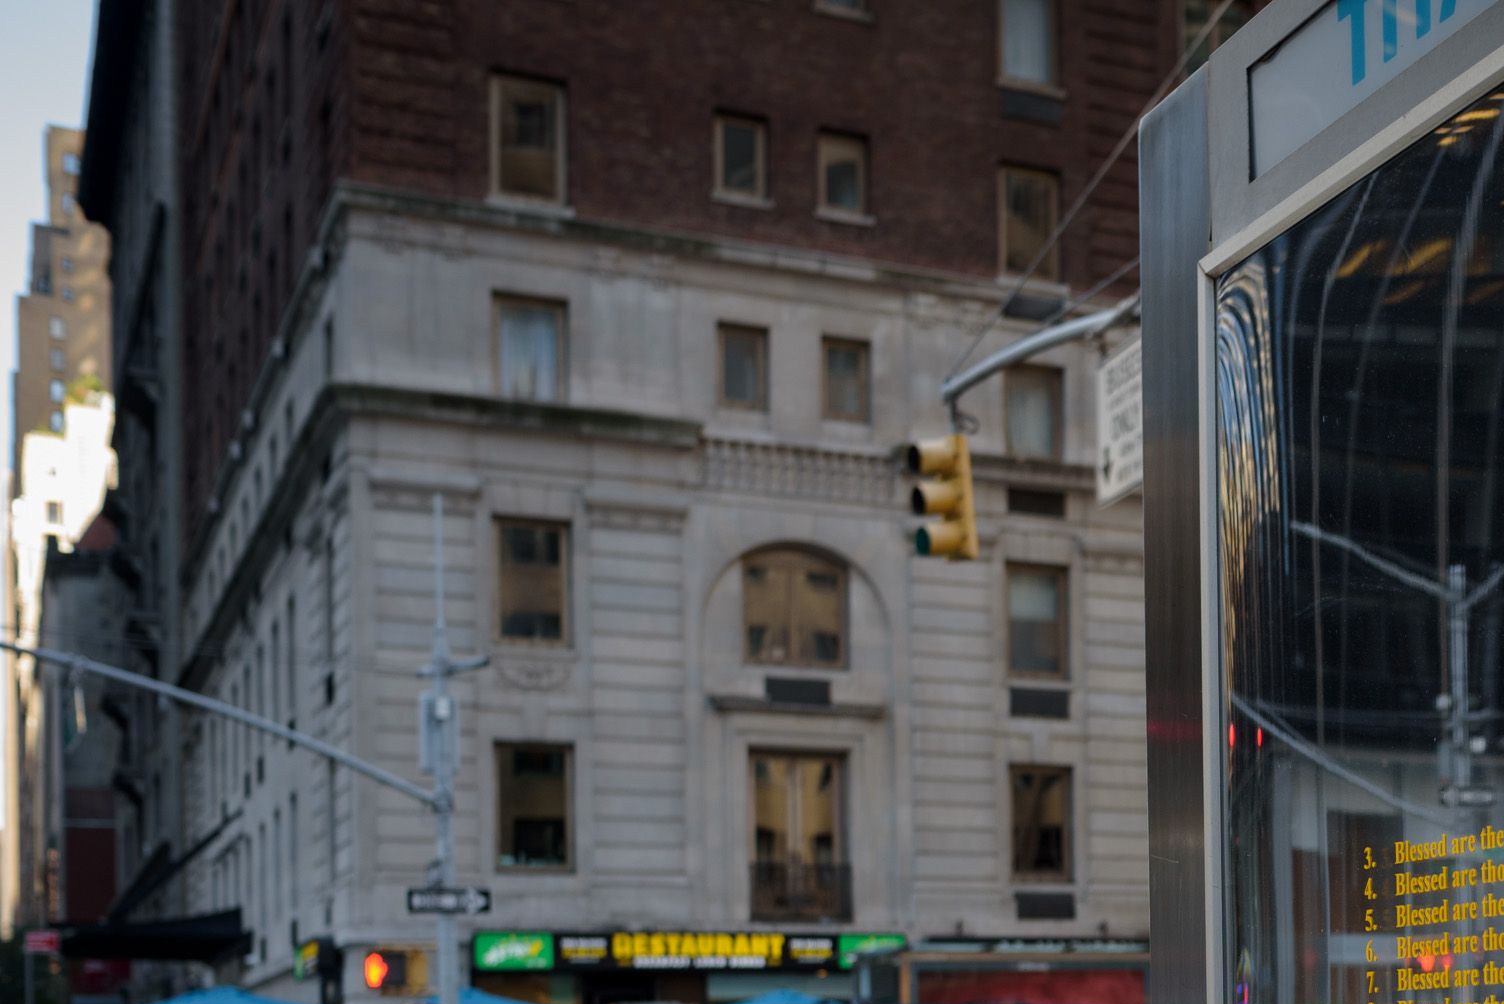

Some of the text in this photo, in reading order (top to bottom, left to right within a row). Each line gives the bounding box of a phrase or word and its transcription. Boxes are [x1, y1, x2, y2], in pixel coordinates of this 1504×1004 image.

[1363, 846, 1377, 870] 3.
[1395, 833, 1447, 864] Blessed
[1451, 834, 1476, 854] are
[1480, 825, 1504, 849] the
[1363, 878, 1377, 900] 4.
[1395, 866, 1448, 896] Blessed
[1452, 867, 1477, 887] are
[1364, 909, 1377, 931] 5.
[1395, 899, 1448, 928] Blessed
[1453, 901, 1477, 920] are
[612, 932, 784, 957] RESTAURANT
[1366, 939, 1377, 962] 6.
[1396, 932, 1449, 959] Blessed
[1453, 934, 1478, 953] are
[1366, 971, 1379, 994] 7.
[1397, 966, 1449, 991] Blessed
[1454, 969, 1479, 986] are
